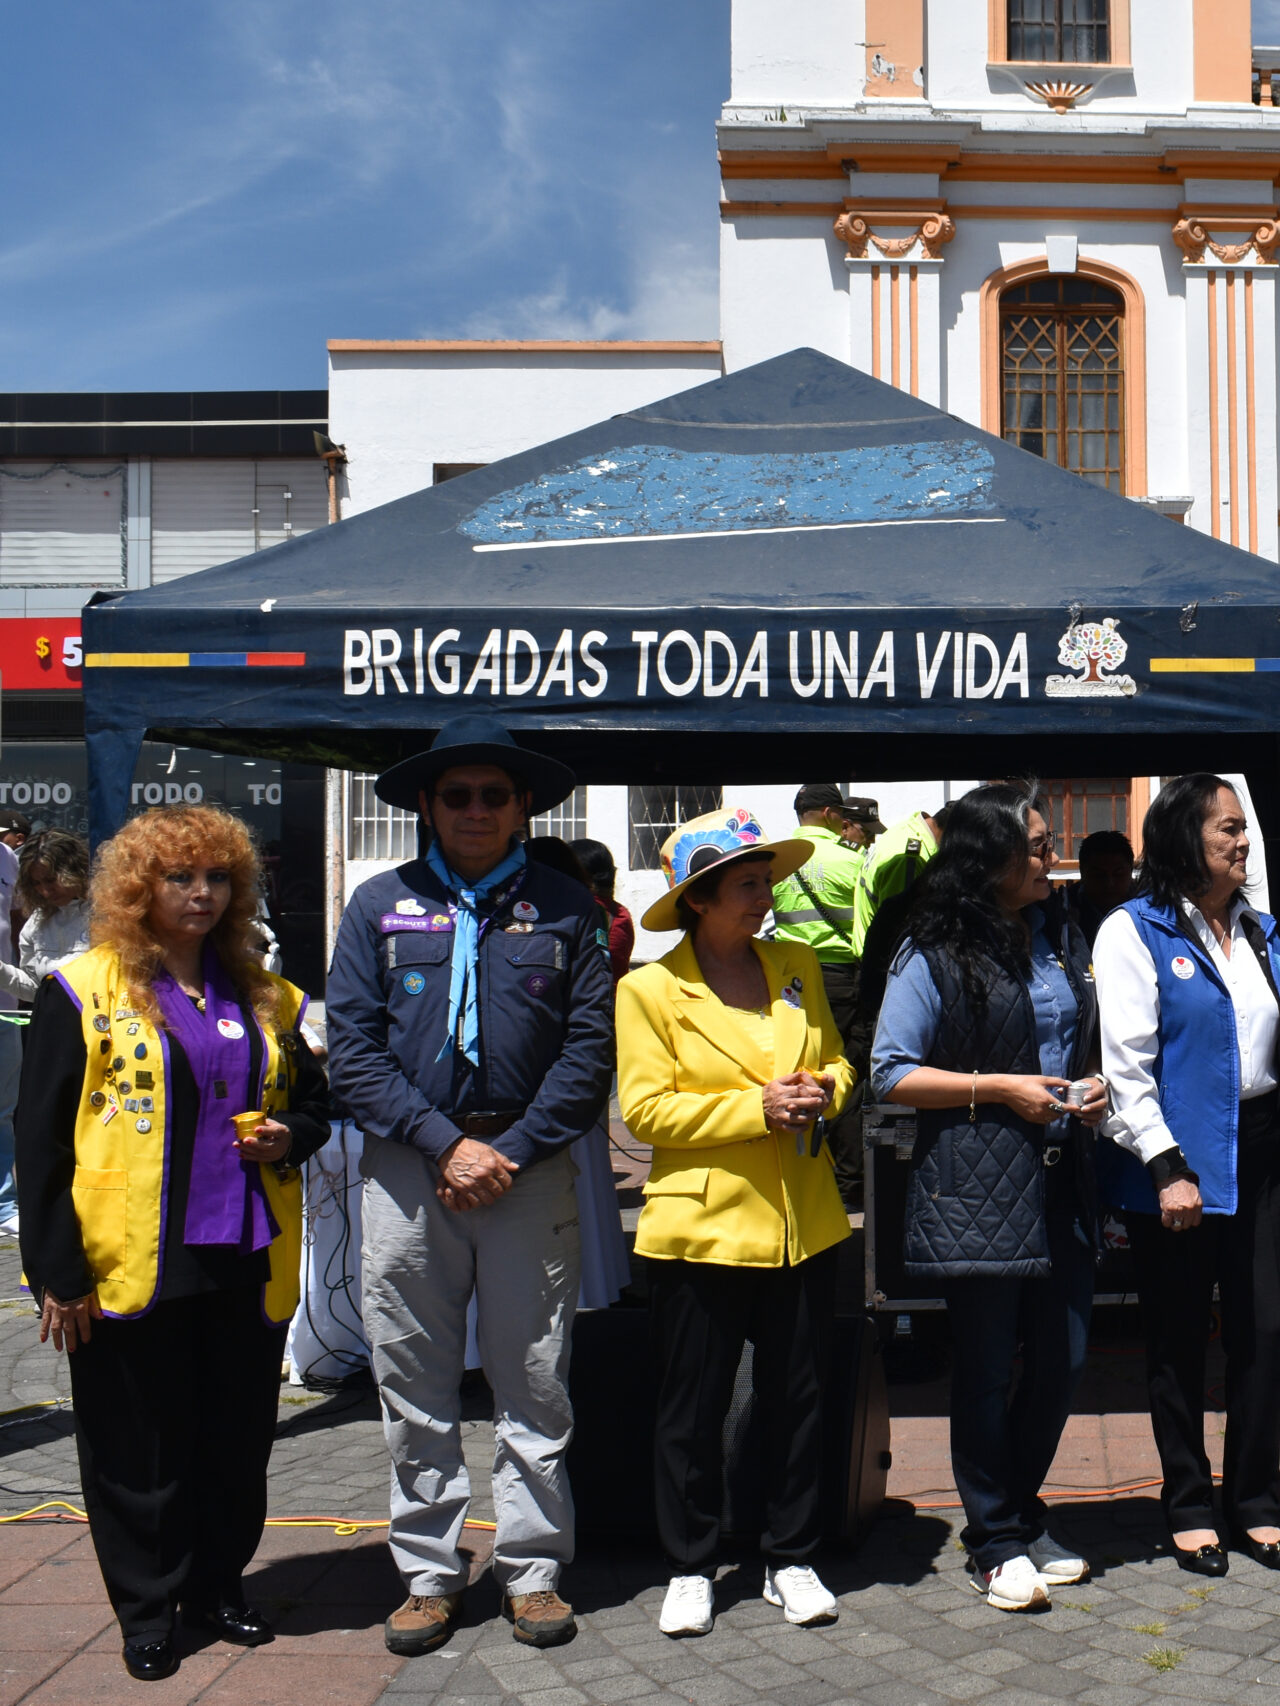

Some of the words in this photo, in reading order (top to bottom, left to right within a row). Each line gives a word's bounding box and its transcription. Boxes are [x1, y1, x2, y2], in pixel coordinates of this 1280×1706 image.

[343, 627, 609, 697] BRIGADAS
[632, 629, 770, 699] TODA
[789, 628, 896, 699] UNA
[916, 630, 1030, 699] VIDA
[0, 782, 72, 805] TODO
